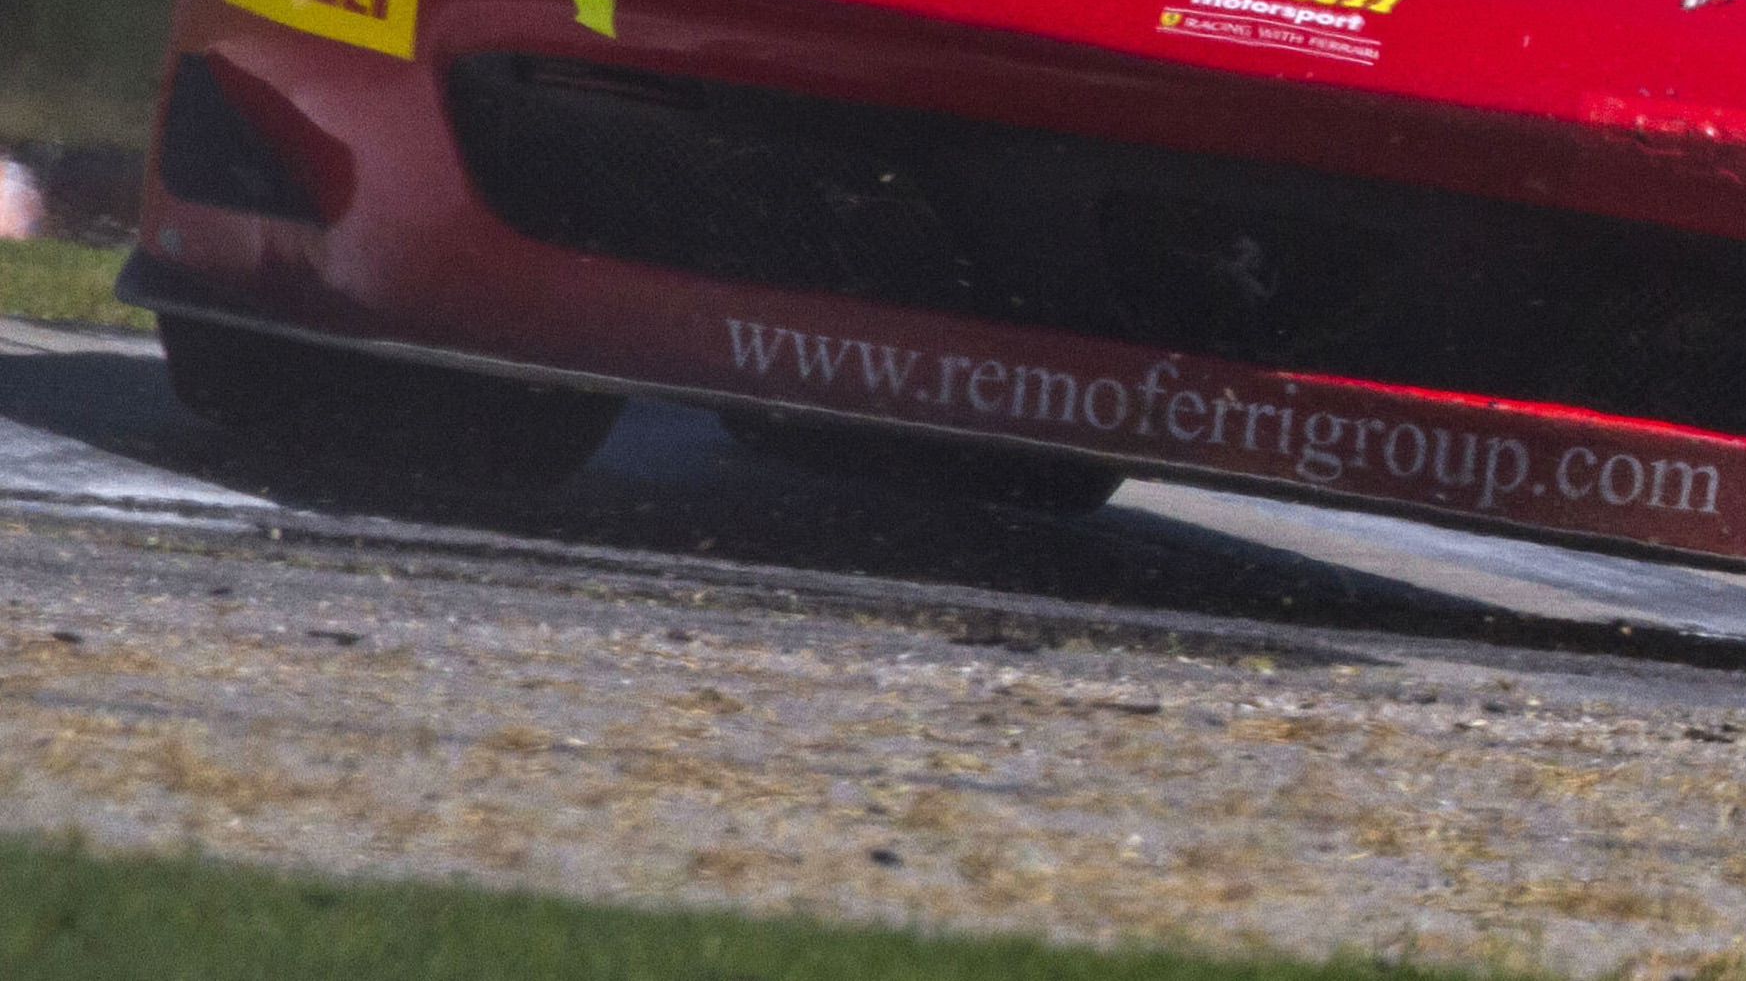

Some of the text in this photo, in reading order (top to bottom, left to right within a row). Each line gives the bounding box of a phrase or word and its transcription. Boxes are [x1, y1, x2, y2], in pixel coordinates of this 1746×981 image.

[1182, 17, 1254, 38] RACING
[1257, 26, 1306, 45] WITH
[725, 316, 1723, 514] www.remoferrigroup.com
